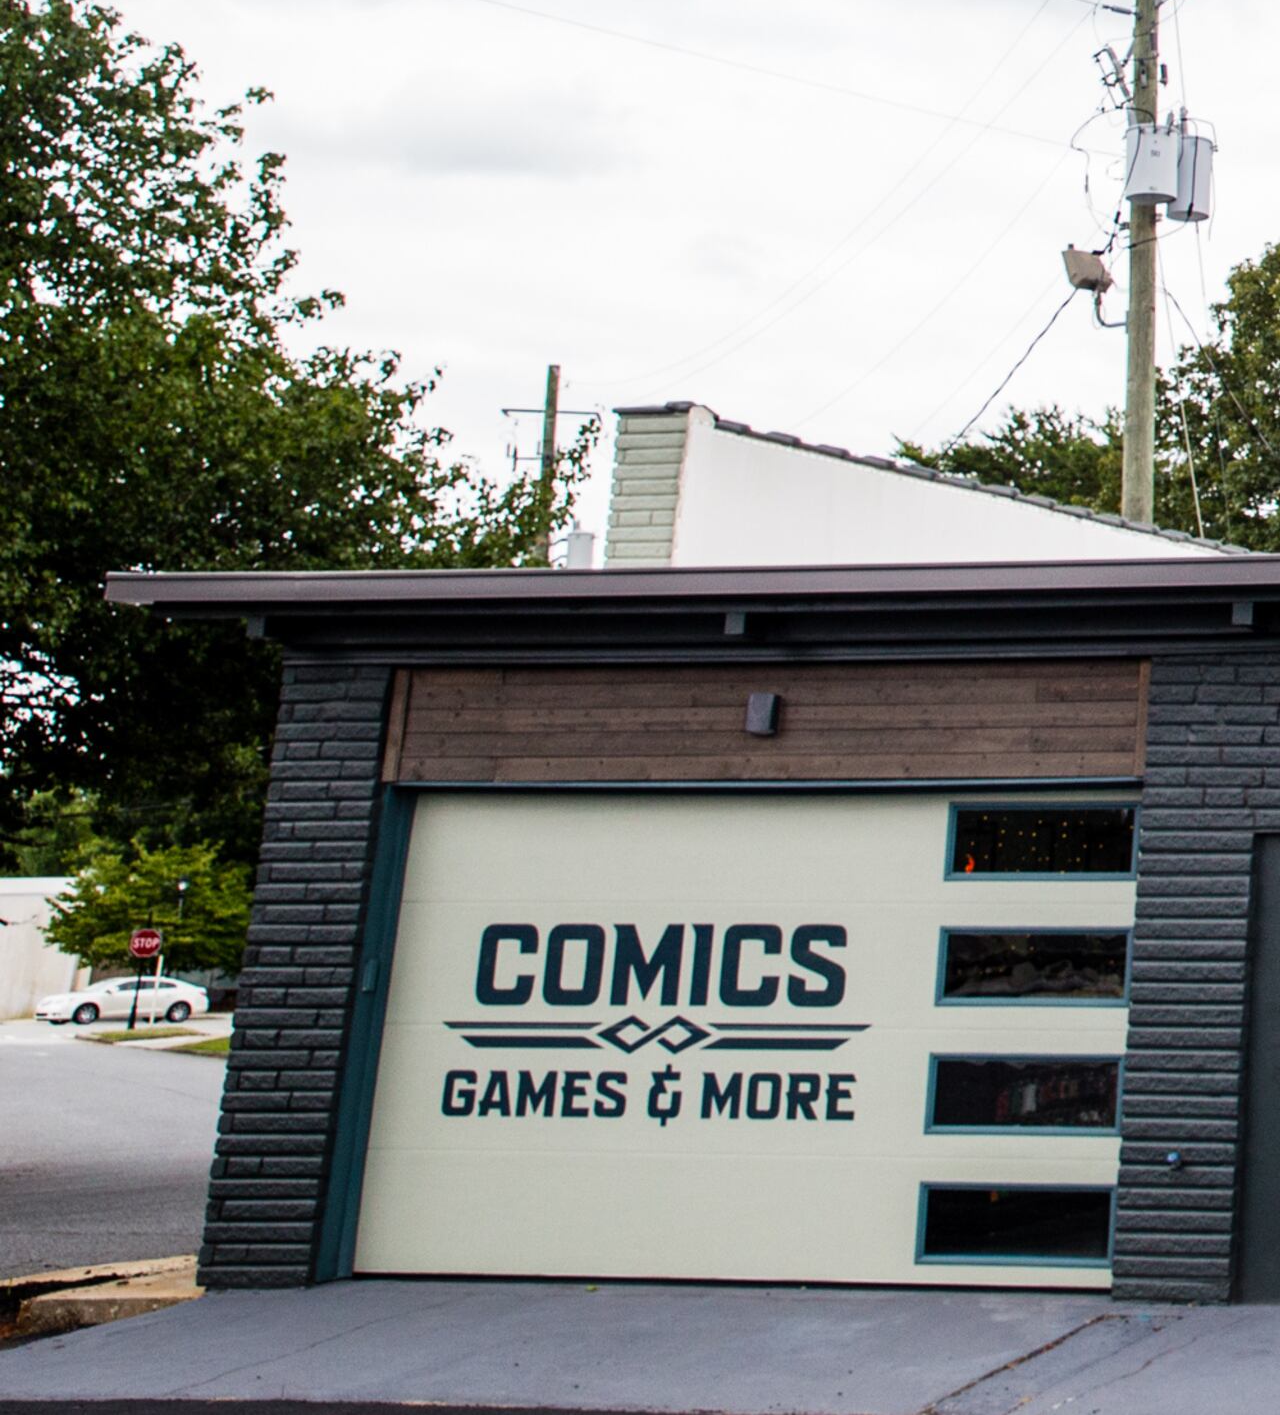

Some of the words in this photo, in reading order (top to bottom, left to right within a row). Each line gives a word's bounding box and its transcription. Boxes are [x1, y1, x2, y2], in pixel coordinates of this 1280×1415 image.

[133, 938, 160, 948] STOP
[475, 923, 848, 1008] COMICS
[440, 1070, 628, 1121] GAMES
[646, 1062, 684, 1128] &
[700, 1071, 857, 1122] MORE
